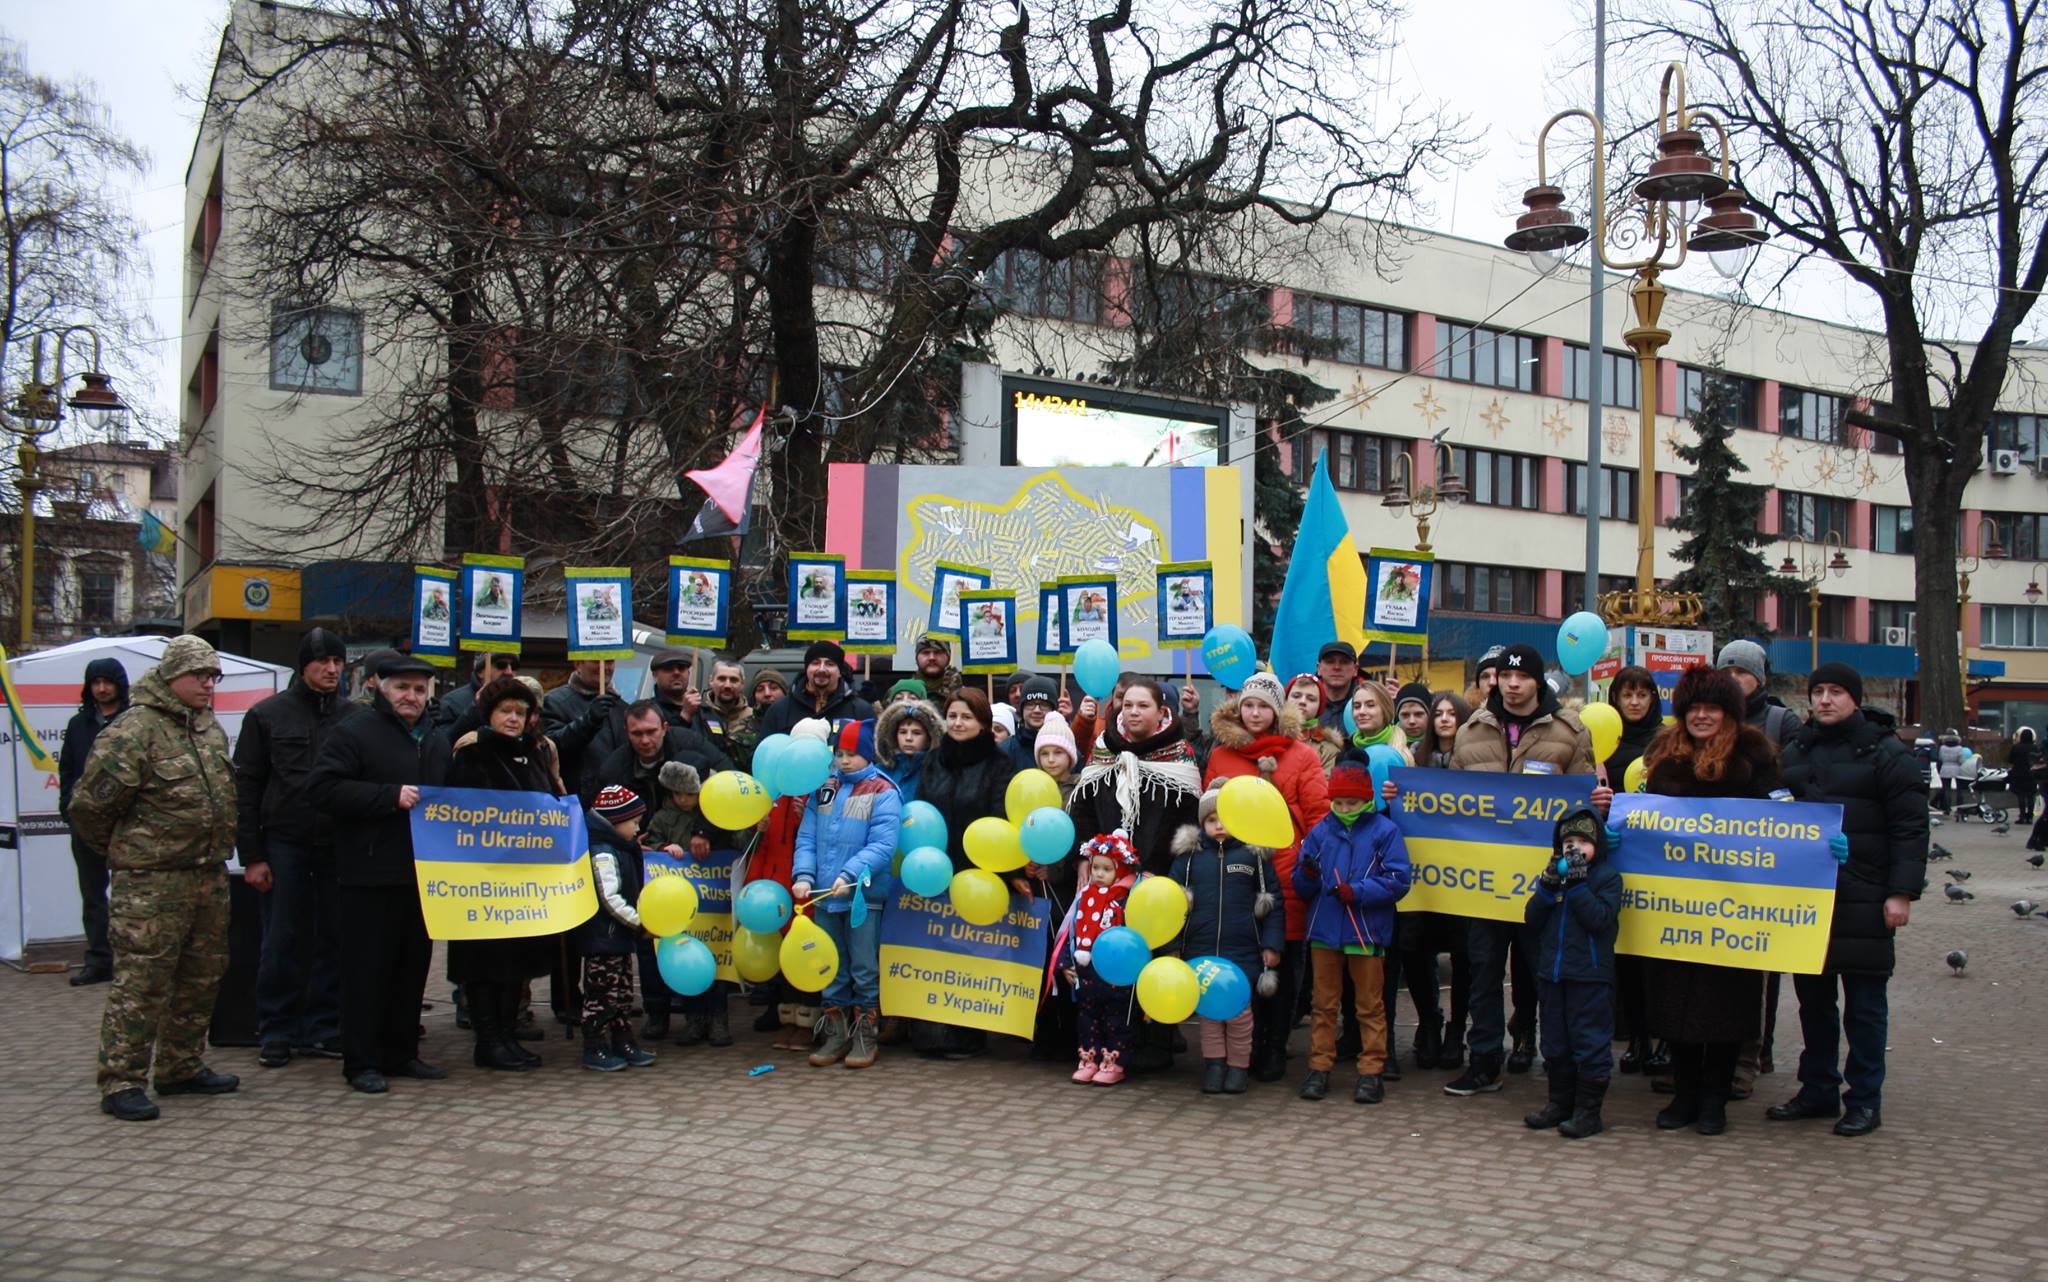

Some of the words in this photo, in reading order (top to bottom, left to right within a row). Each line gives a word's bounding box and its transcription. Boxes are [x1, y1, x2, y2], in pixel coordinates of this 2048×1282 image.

[1015, 391, 1087, 416] 14:42:41
[1206, 643, 1231, 659] STOP
[734, 772, 749, 795] STO
[599, 797, 625, 806] SPORT
[1402, 791, 1583, 824] #OSCE_24/2
[1626, 809, 1821, 841] #MoreSanctions
[457, 829, 474, 847] in
[481, 830, 553, 849] Ukraine
[1664, 841, 1686, 862] to
[1693, 842, 1775, 869] Russia
[427, 876, 585, 901] #СтопВійніПутіна
[1410, 862, 1541, 900] #OSCE_24
[467, 908, 477, 922] в
[483, 904, 549, 925] Україні
[1620, 889, 1817, 927] #БільшеСанкцій
[927, 919, 944, 937] in
[951, 922, 1020, 948] Ukraine
[1660, 926, 1703, 946] для
[1711, 926, 1771, 952] Росії
[889, 961, 1035, 1001] #СтопВійніПутіна
[927, 991, 937, 1005] в
[943, 991, 1005, 1016] Україні
